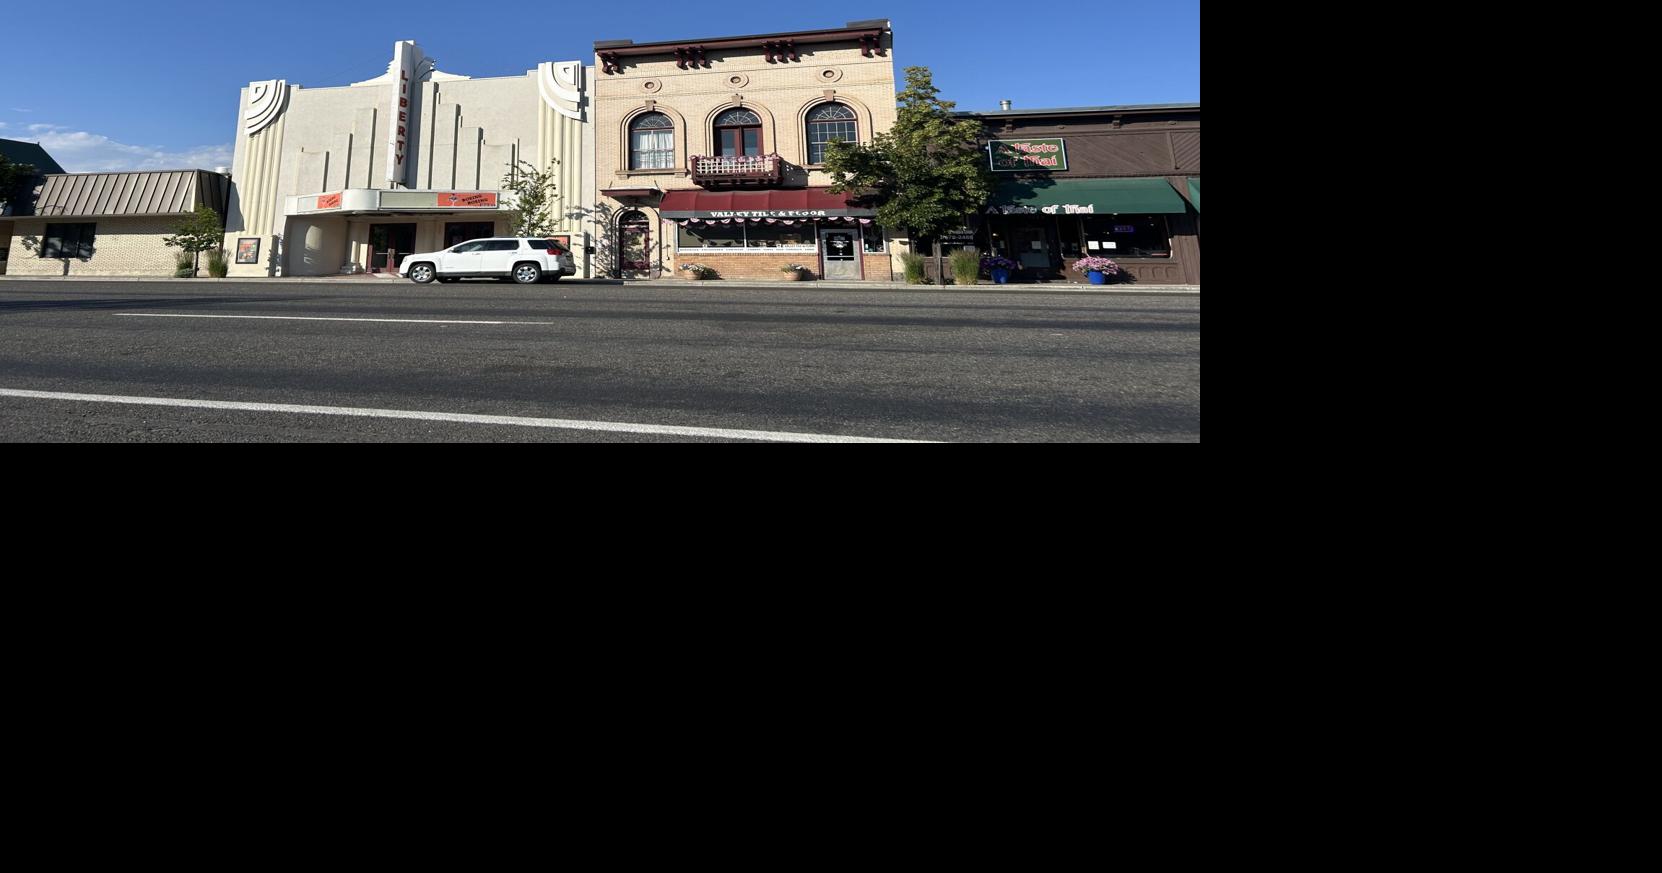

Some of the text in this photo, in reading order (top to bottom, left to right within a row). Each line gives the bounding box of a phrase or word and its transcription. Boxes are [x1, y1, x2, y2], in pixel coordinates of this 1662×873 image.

[396, 70, 408, 165] LIBERTY
[1011, 143, 1059, 153] Taste
[1020, 154, 1057, 167] Thai
[985, 204, 1093, 215] A Taste of Thai
